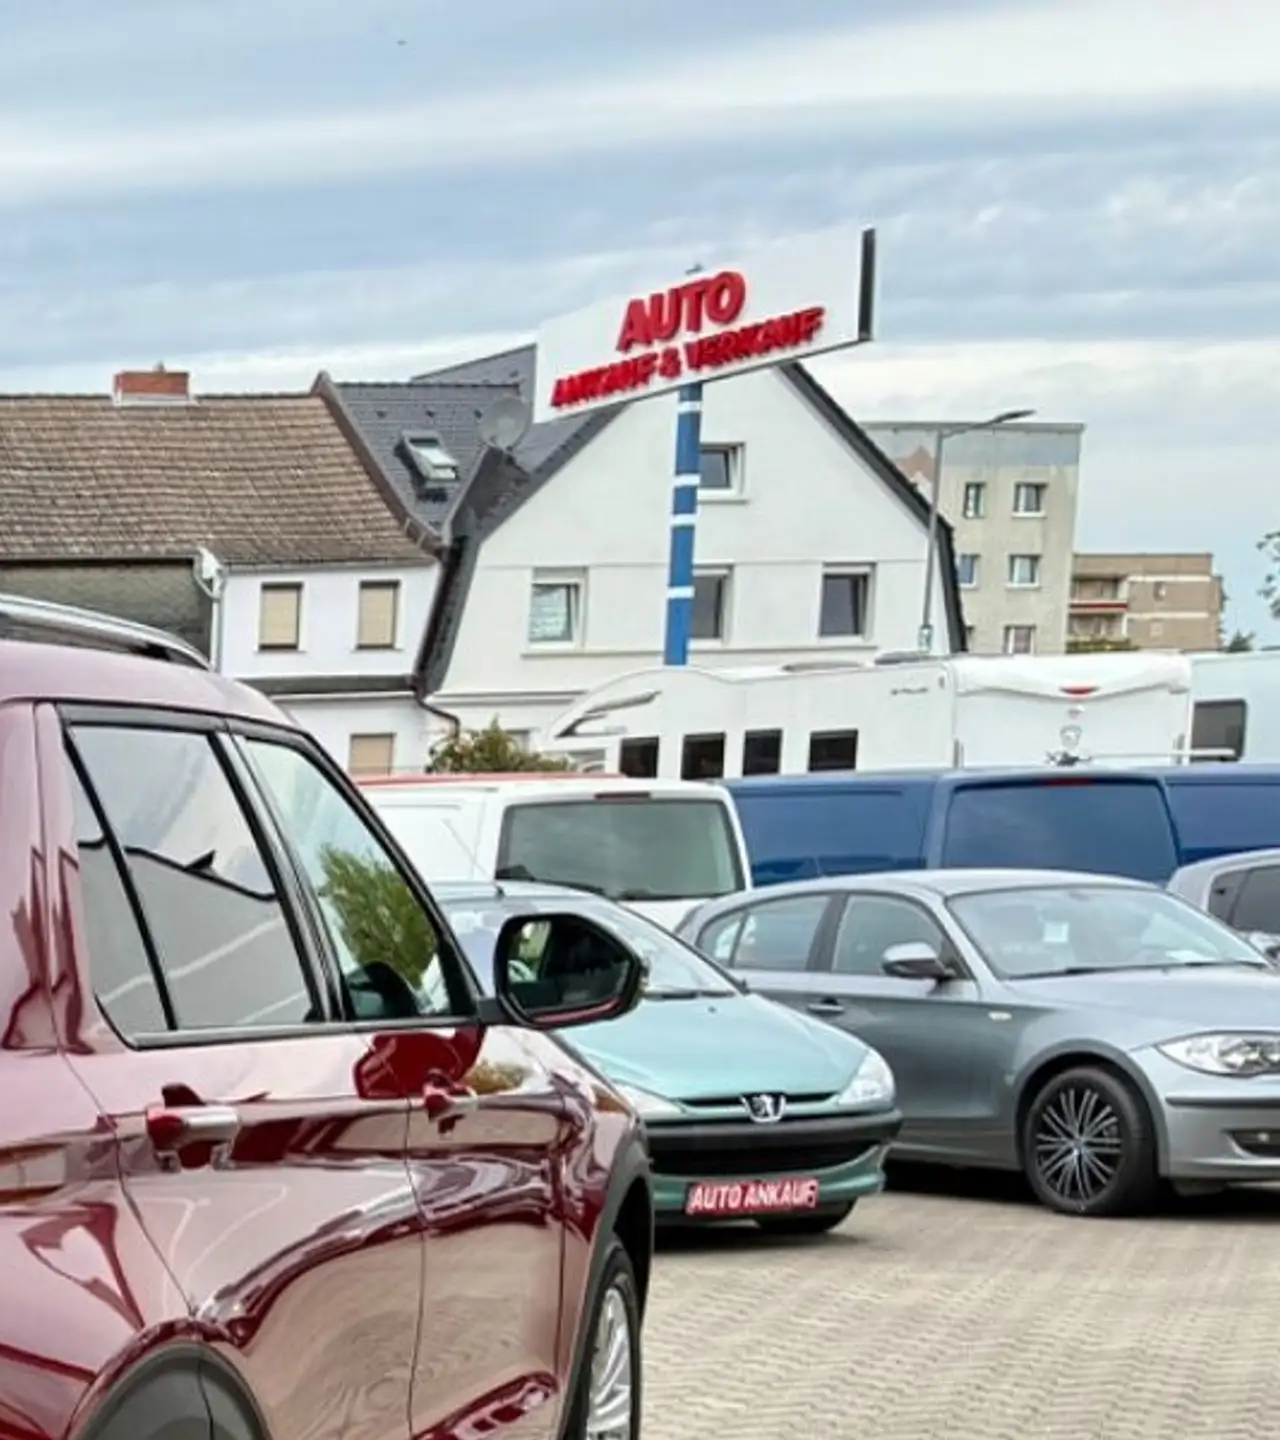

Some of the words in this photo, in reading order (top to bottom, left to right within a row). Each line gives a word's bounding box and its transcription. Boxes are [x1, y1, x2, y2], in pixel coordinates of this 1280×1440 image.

[616, 271, 746, 352] AUTO
[550, 351, 657, 408] ANKAUF
[657, 346, 682, 379] &
[685, 306, 826, 369] VERKAUF
[689, 1184, 742, 1211] AUTO
[745, 1179, 818, 1209] ANKAUF
